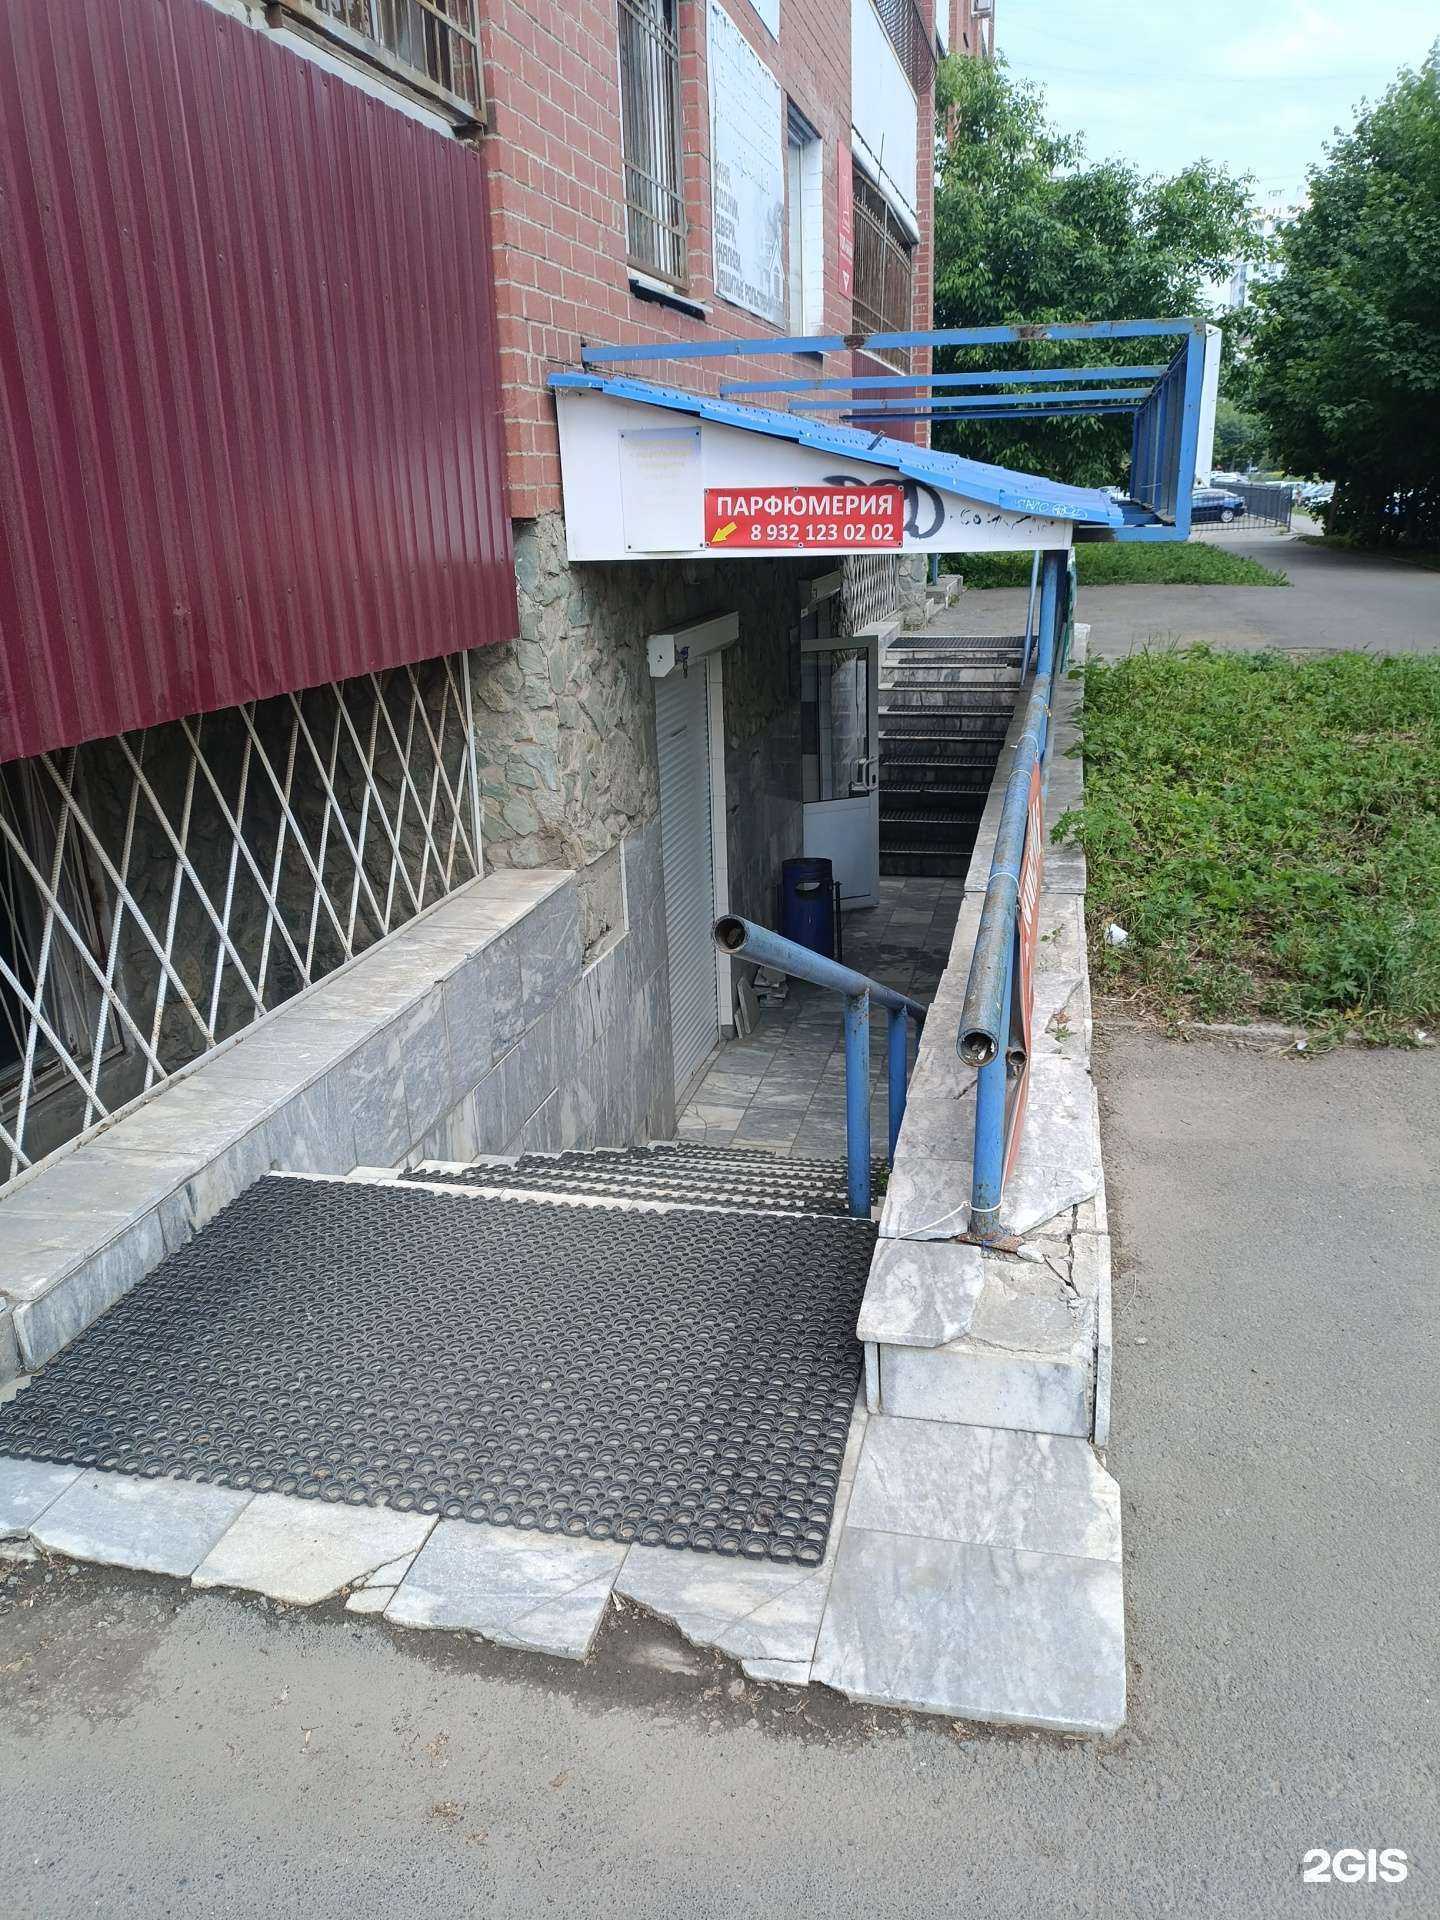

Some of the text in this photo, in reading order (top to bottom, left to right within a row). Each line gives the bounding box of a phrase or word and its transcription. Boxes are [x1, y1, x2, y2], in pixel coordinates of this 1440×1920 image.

[717, 495, 893, 516] ПАРФЮМЕРИЯ
[751, 523, 894, 541] 8 932 123 02 02
